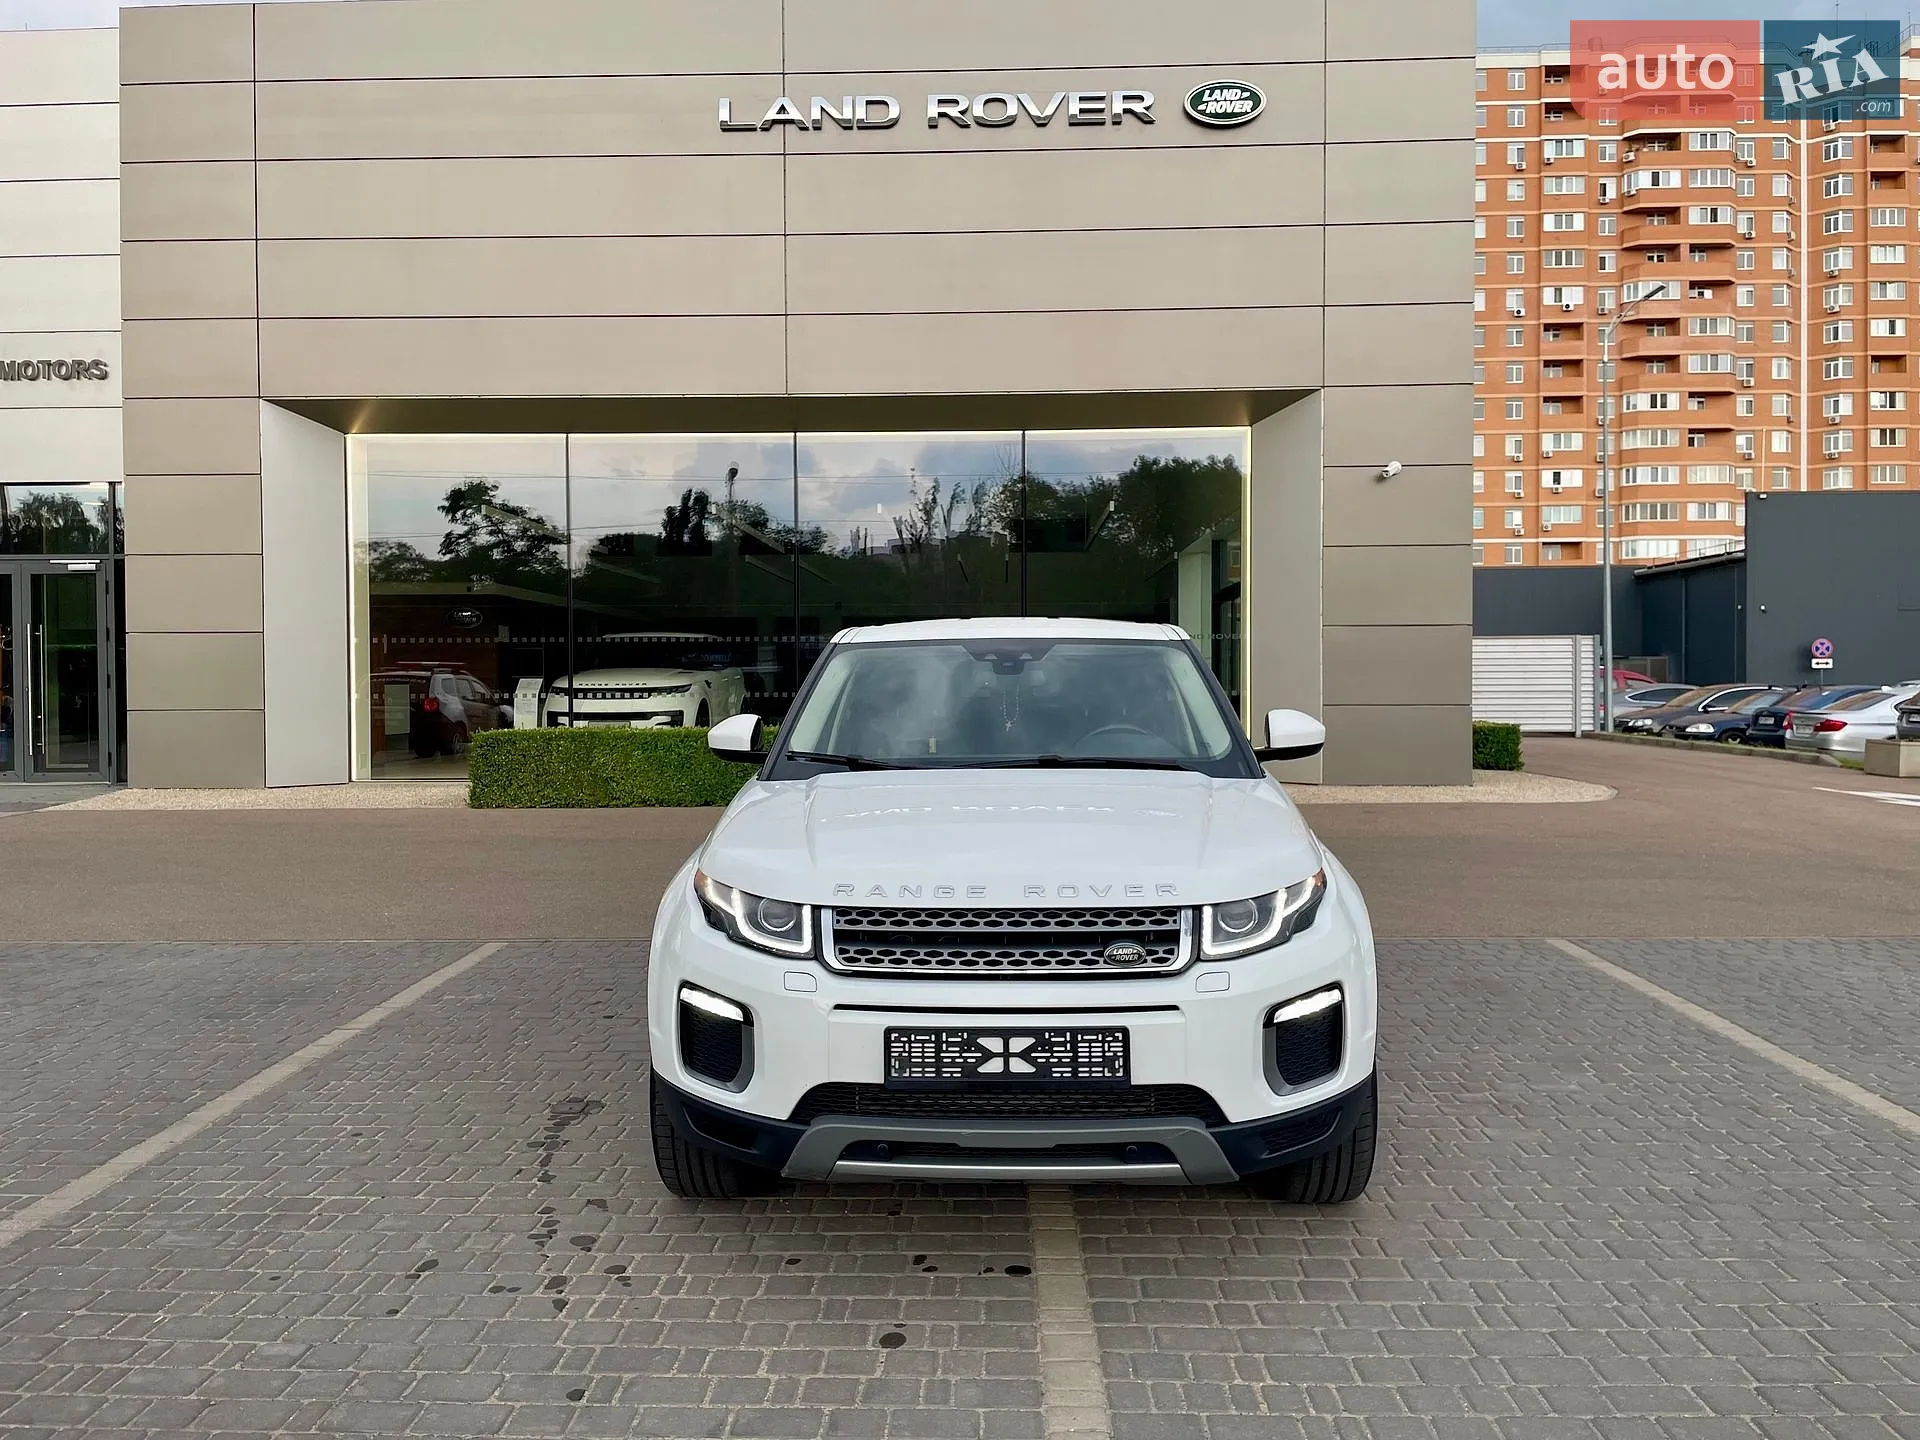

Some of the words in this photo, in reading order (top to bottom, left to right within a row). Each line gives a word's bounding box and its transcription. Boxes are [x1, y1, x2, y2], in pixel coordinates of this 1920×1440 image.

[1202, 89, 1242, 101] LAND
[719, 95, 900, 131] LAND
[927, 90, 1156, 128] ROVER
[1205, 100, 1253, 114] ROVER
[0, 359, 109, 381] MOTORS
[832, 883, 987, 899] RANGE
[1023, 883, 1180, 898] ROVER
